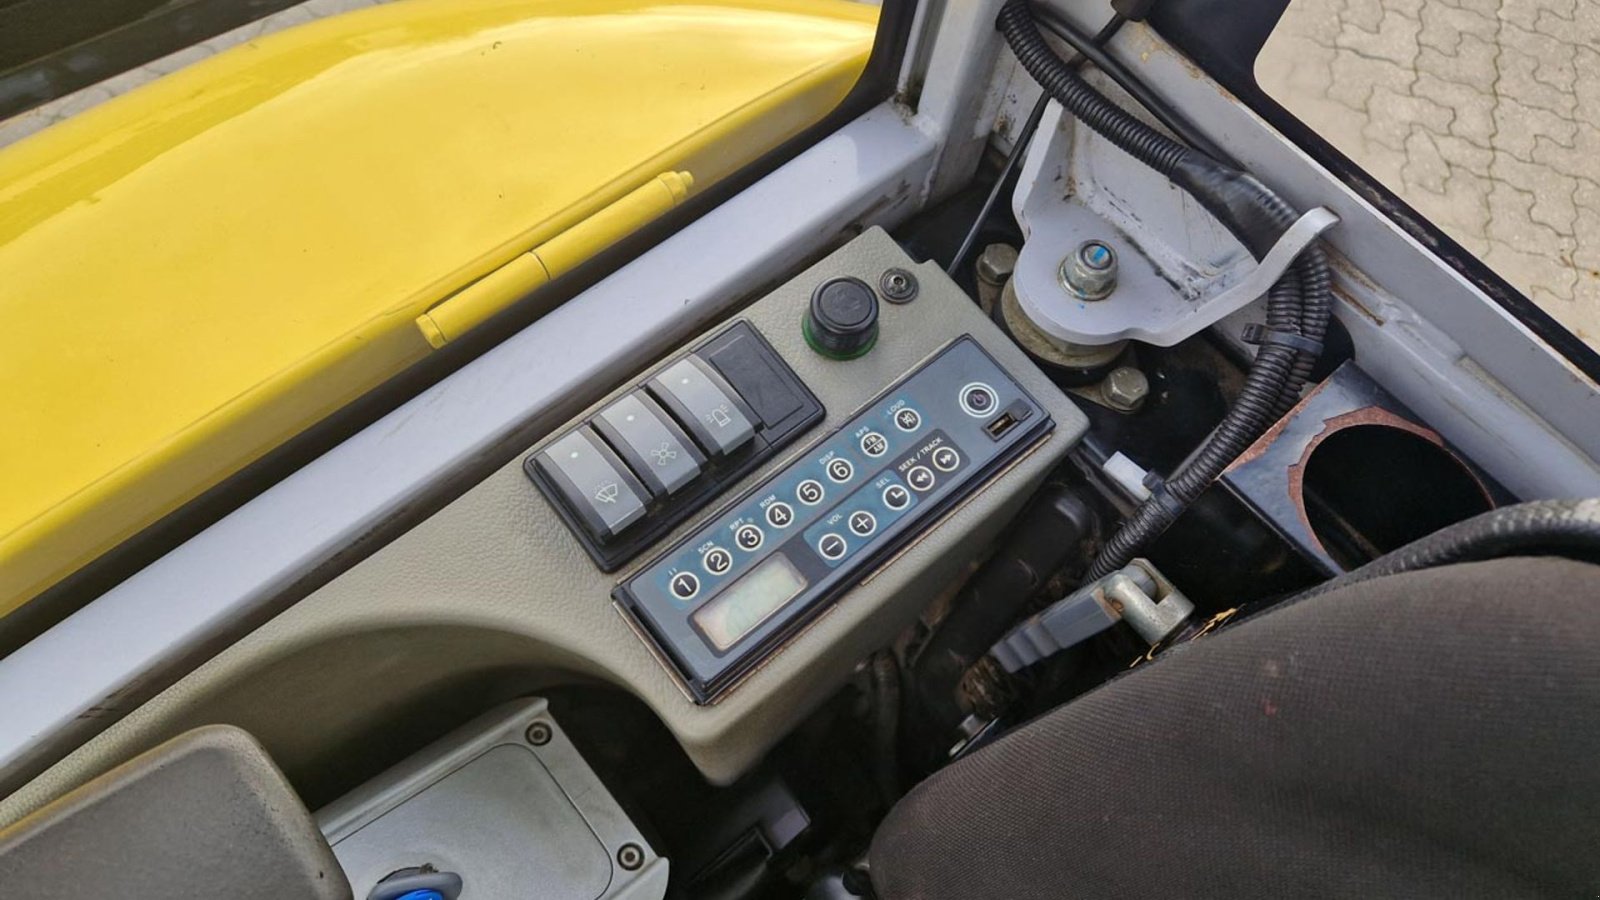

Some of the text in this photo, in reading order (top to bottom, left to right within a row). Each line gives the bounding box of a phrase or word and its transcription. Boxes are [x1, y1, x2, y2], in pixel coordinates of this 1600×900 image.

[888, 400, 906, 416] LOUD
[855, 426, 870, 439] APS
[866, 435, 879, 445] FM
[873, 443, 885, 454] AM
[898, 456, 917, 473] SEEK
[920, 437, 943, 458] TRACK
[833, 463, 849, 478] 6
[875, 477, 890, 489] SEL
[802, 484, 819, 501] 5
[774, 507, 787, 522] 4
[826, 513, 843, 526] VOL
[729, 518, 745, 531] RPT
[741, 529, 758, 546] 3
[698, 540, 715, 554] SCN
[711, 552, 728, 570] 2
[678, 578, 693, 593] 1
